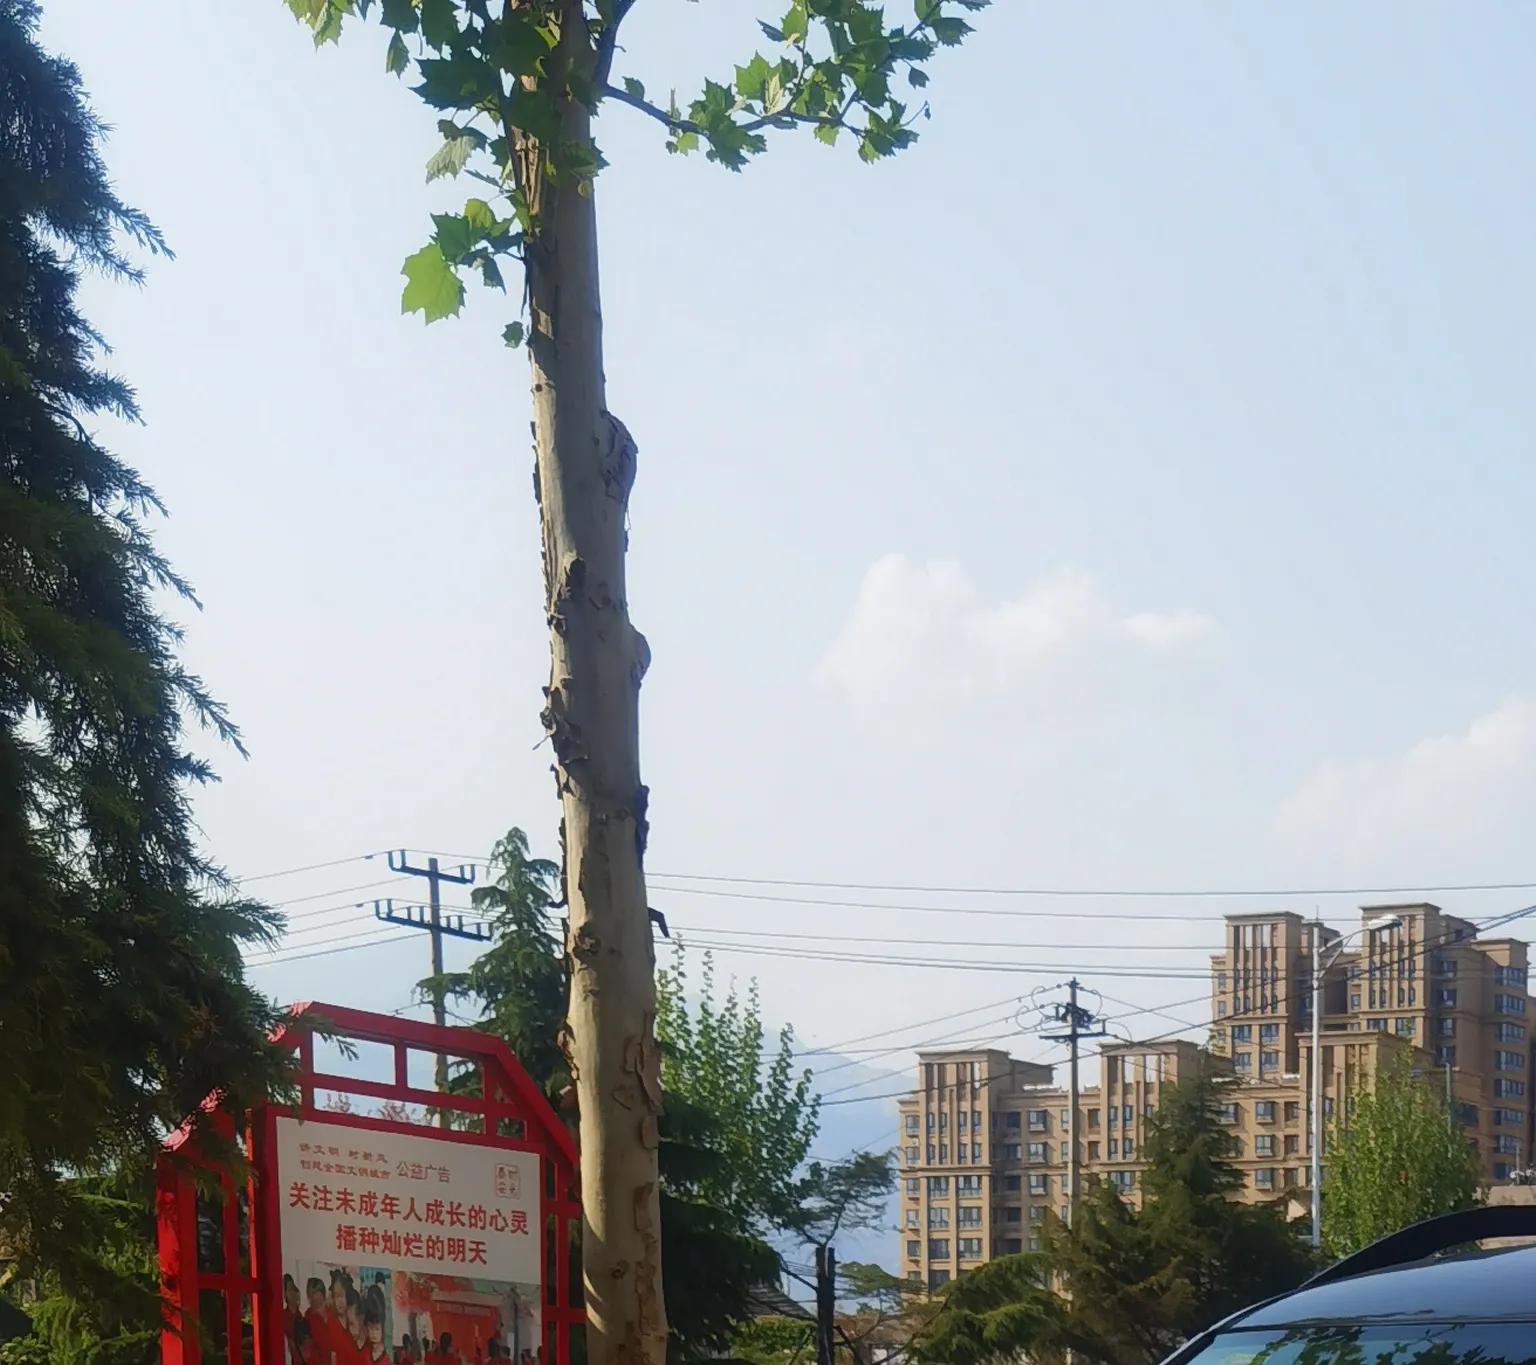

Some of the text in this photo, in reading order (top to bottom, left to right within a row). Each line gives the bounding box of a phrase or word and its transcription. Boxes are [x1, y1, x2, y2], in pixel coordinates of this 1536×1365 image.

[396, 1161, 451, 1184] 公益广告
[289, 1182, 529, 1236] 关注未成年人成长的心灵
[336, 1223, 488, 1265] 播种灿烂的明天
